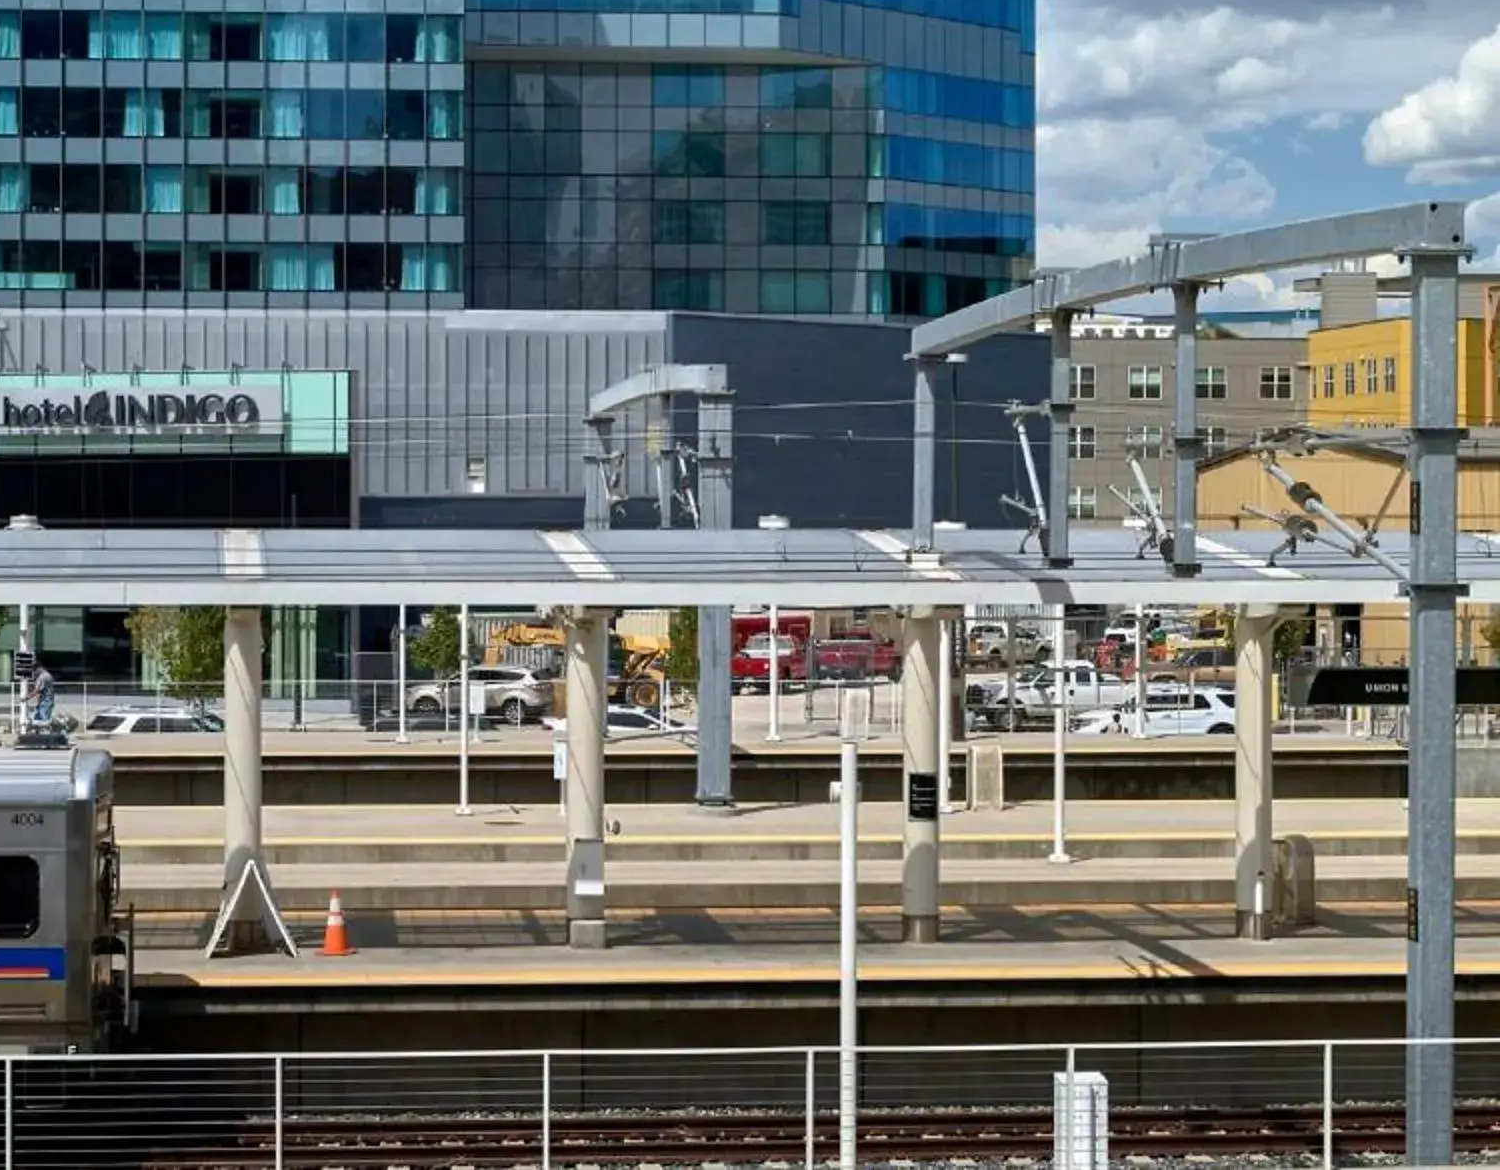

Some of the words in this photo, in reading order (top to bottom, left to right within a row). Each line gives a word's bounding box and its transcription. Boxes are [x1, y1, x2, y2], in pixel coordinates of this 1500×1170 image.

[3, 395, 82, 427] hotel
[115, 393, 260, 427] INDIGO
[1365, 683, 1399, 693] UNION
[11, 812, 44, 827] 4004
